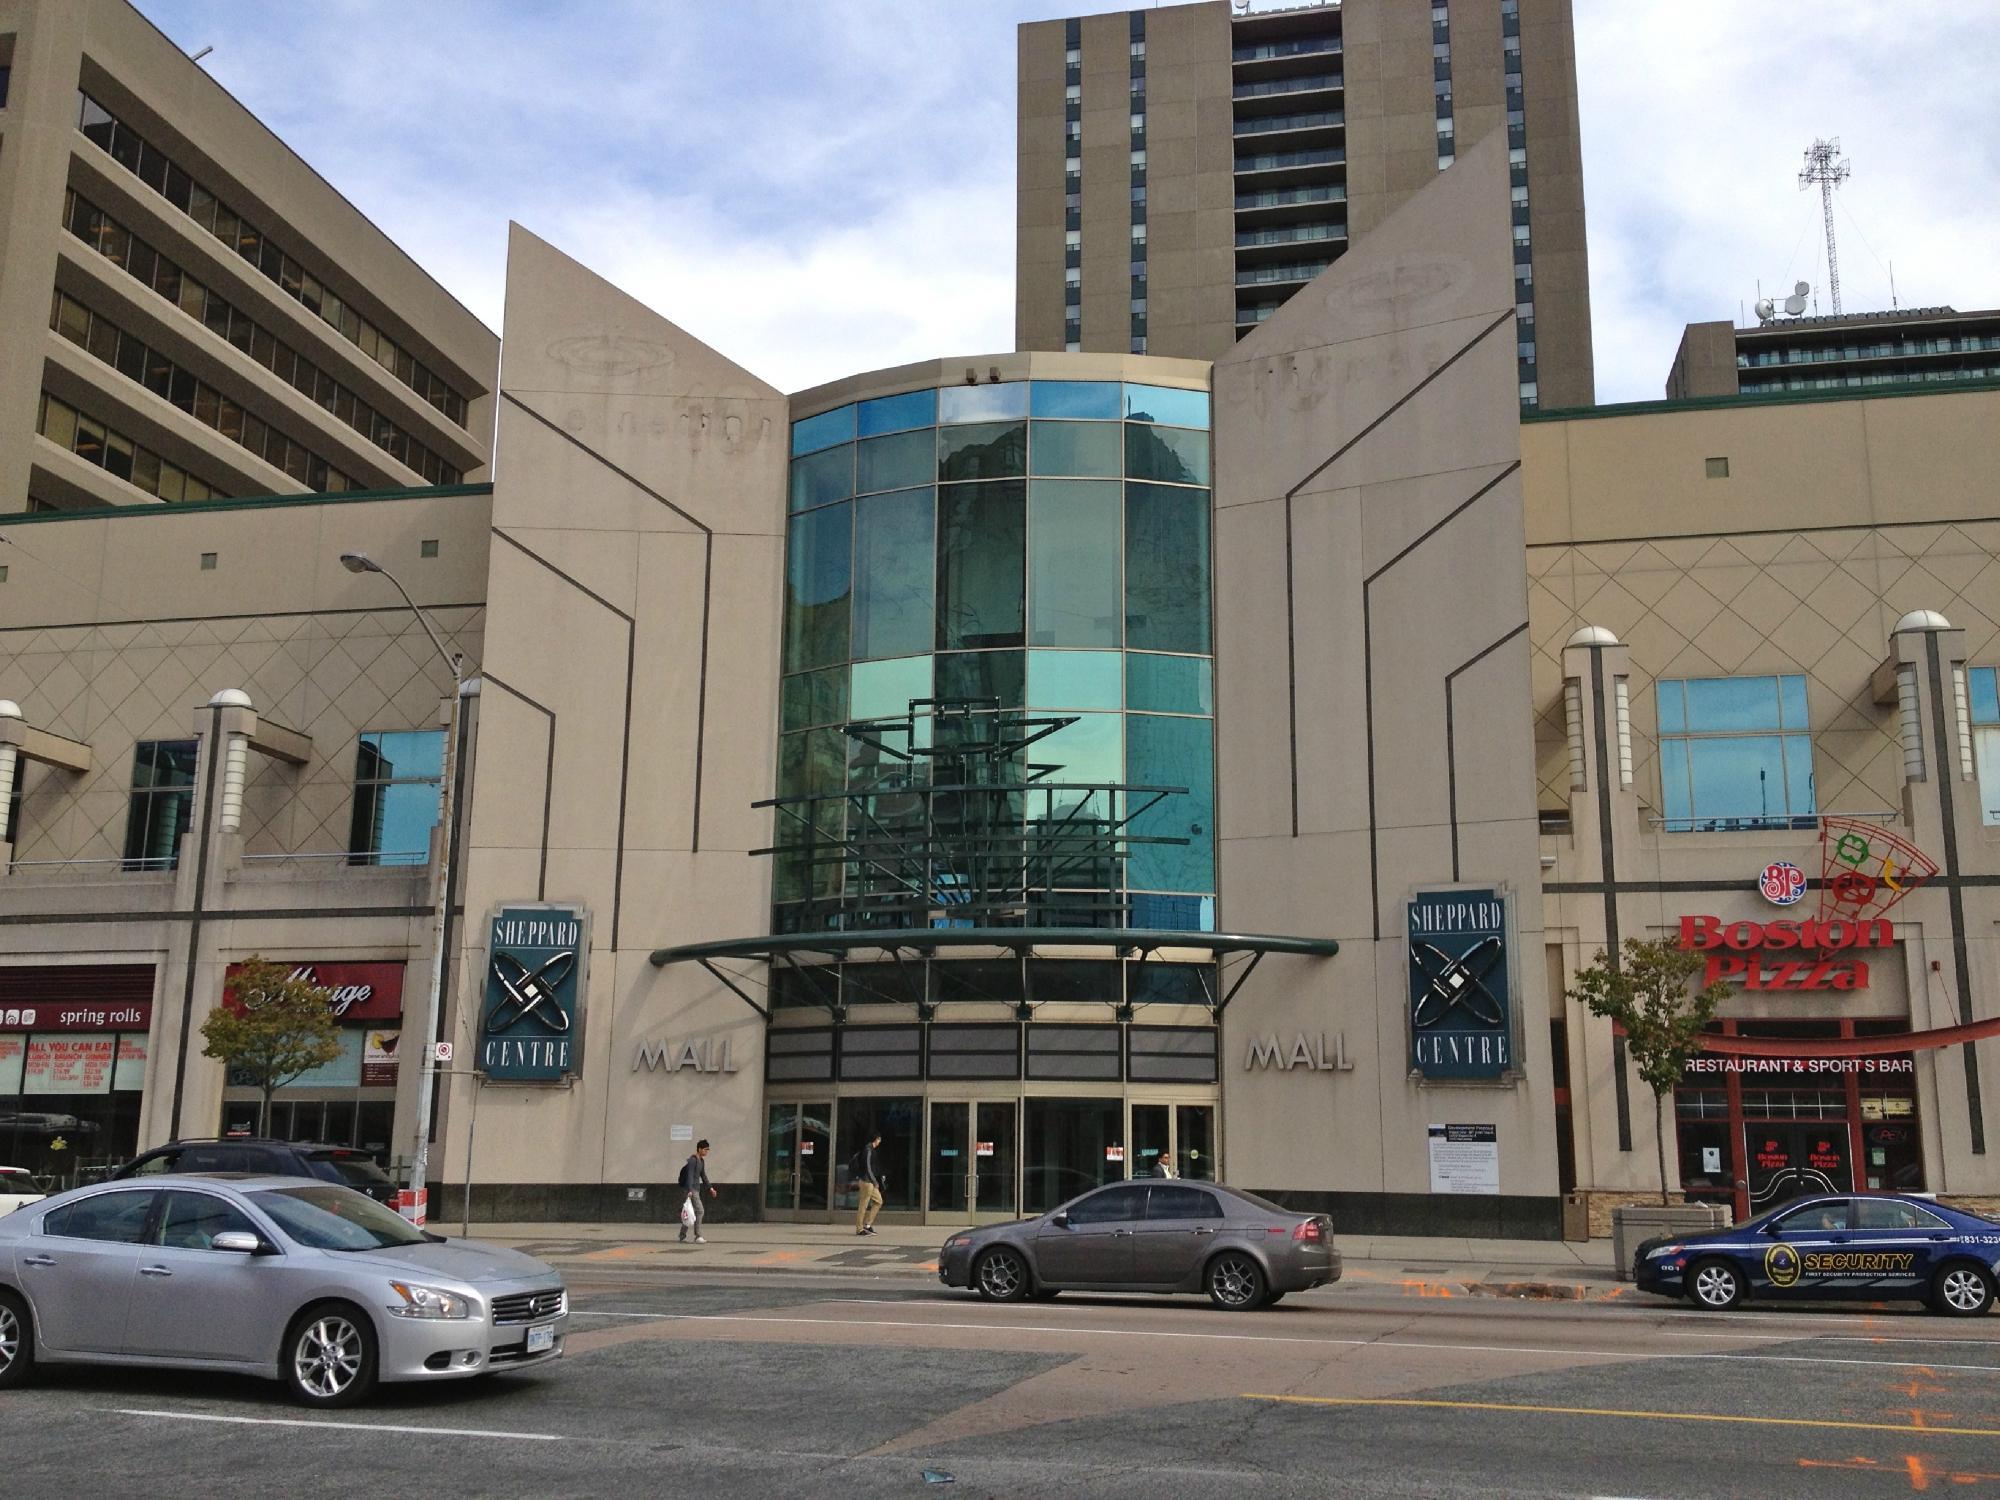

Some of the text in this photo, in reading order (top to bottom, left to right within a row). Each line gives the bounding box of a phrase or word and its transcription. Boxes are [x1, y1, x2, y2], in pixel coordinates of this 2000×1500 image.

[1763, 863, 1805, 899] BP
[1411, 902, 1501, 931] SHEPPARD
[494, 920, 578, 946] SHEPPARD
[1678, 914, 1894, 950] Boston
[1703, 953, 1870, 991] Pizza
[60, 1008, 142, 1026] spring rolls
[28, 1042, 46, 1052] ALL
[48, 1042, 69, 1052] YOU
[71, 1042, 93, 1052] CAN
[95, 1042, 113, 1051] EAT
[486, 1041, 569, 1067] CENTRE
[632, 1038, 739, 1073] MALL
[1245, 1033, 1354, 1070] MALL
[1416, 1036, 1508, 1064] CENTRE
[1686, 1059, 1791, 1073] RESTAURANT
[1793, 1059, 1804, 1073] &
[1879, 1059, 1914, 1073] BAR
[1804, 1253, 1914, 1270] SECURITY
